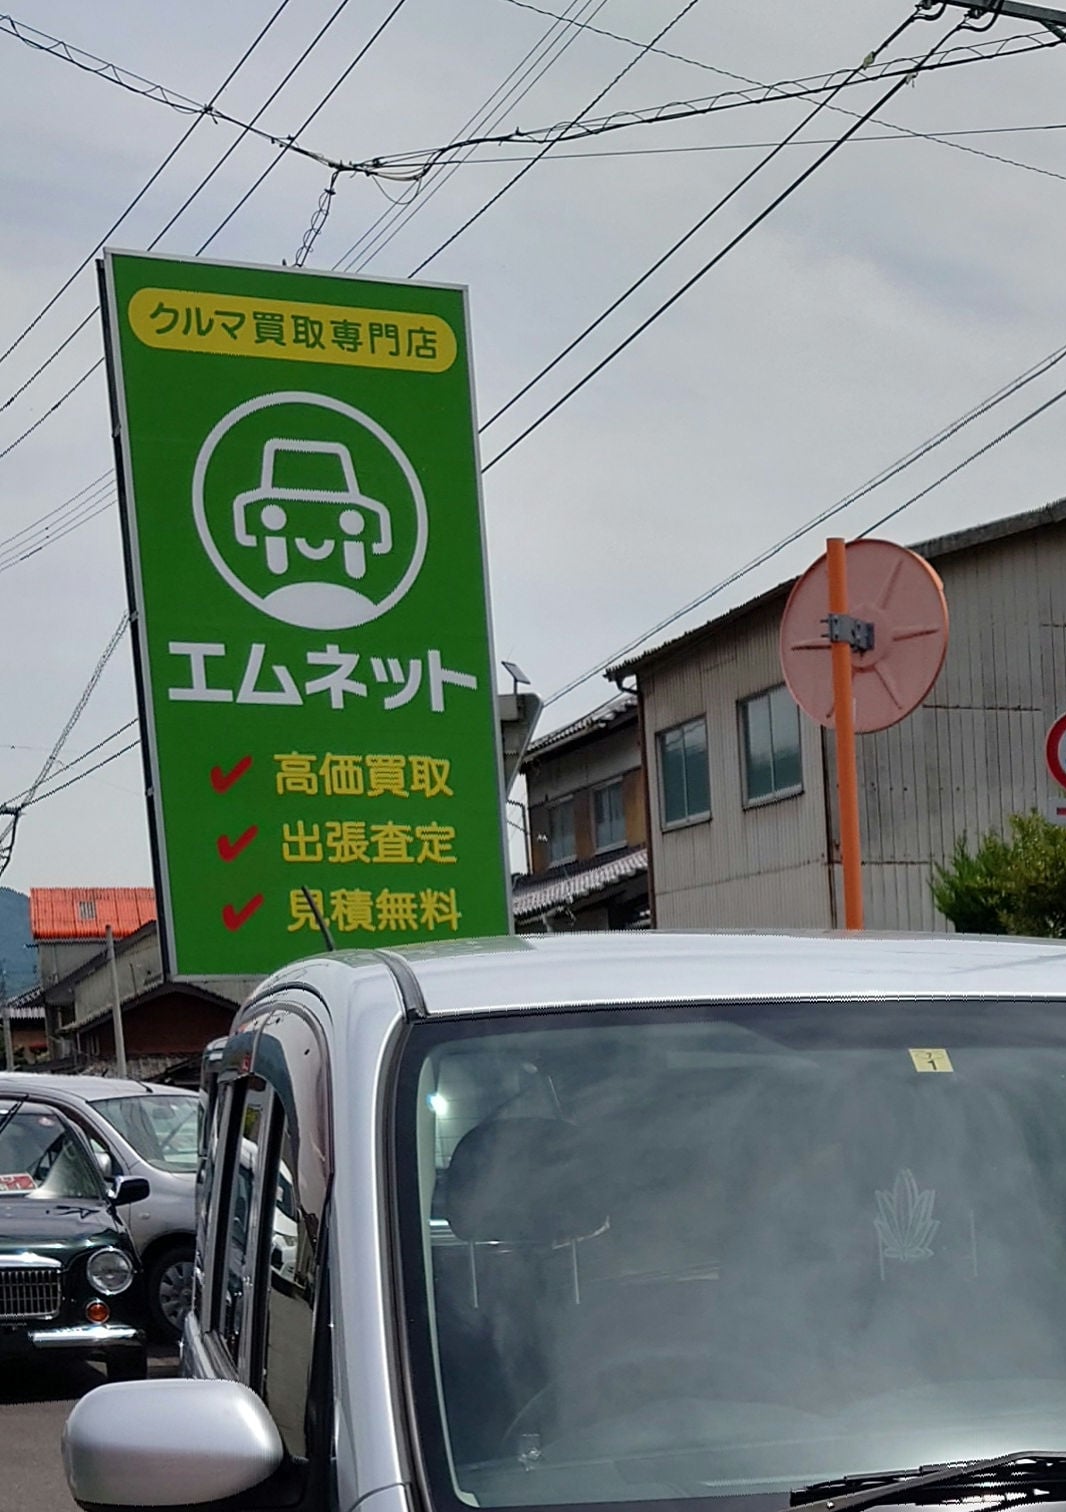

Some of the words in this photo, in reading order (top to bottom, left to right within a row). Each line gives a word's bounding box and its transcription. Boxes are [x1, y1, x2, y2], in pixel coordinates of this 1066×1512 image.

[149, 301, 438, 360] クルマ買取専門店
[168, 641, 478, 712] エムネット
[274, 751, 455, 798] 高価買取
[282, 820, 458, 864] 出張査定
[287, 888, 462, 932] 見積無料
